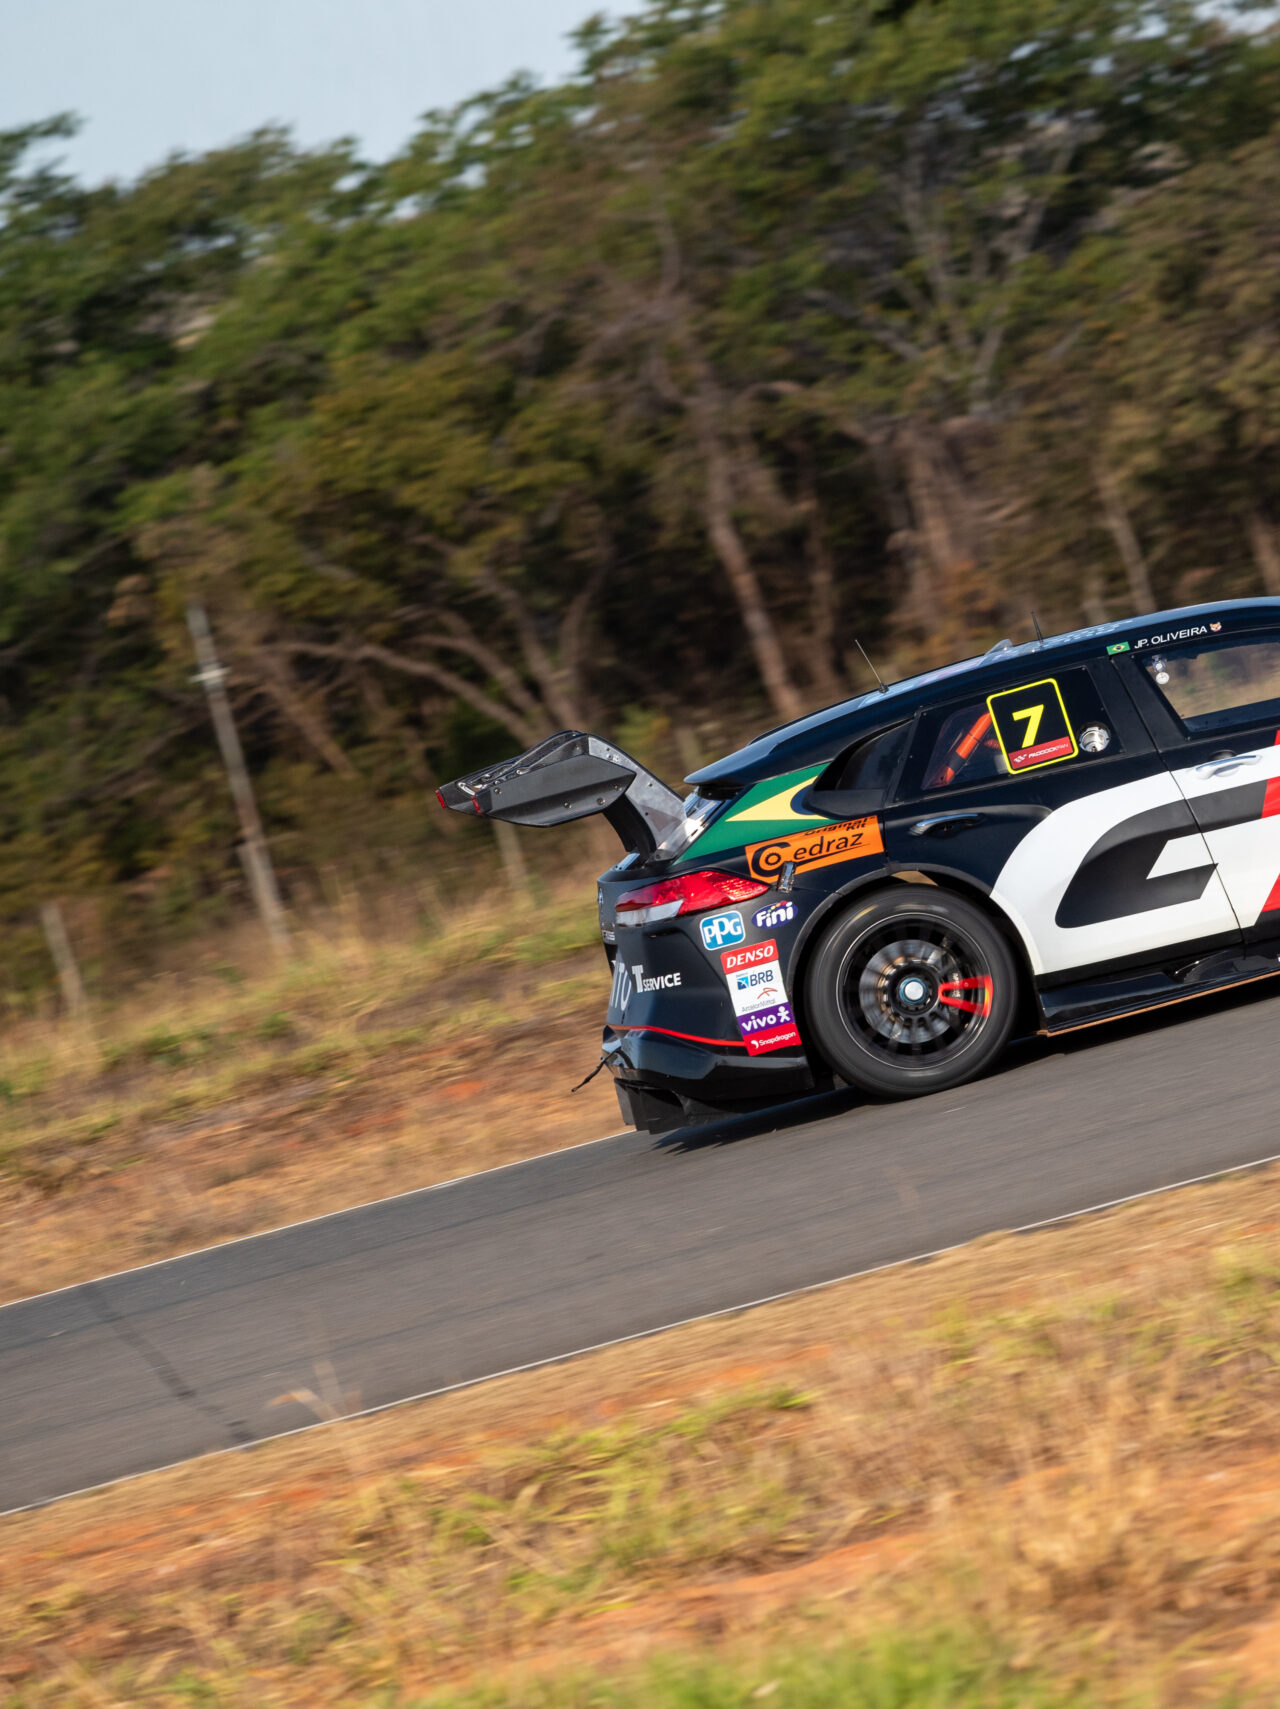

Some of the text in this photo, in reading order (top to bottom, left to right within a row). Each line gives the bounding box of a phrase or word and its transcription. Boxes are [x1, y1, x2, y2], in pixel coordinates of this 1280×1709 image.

[1151, 625, 1208, 646] OLIVEIRA
[1012, 704, 1045, 748] 7
[804, 818, 868, 836] Original
[846, 822, 867, 832] Kit
[756, 901, 795, 928] Fini
[703, 917, 743, 944] PPG
[726, 944, 774, 969] DENSO
[750, 969, 774, 987] BRB
[742, 1014, 777, 1032] vivo
[758, 1031, 796, 1046] Snapdragon
